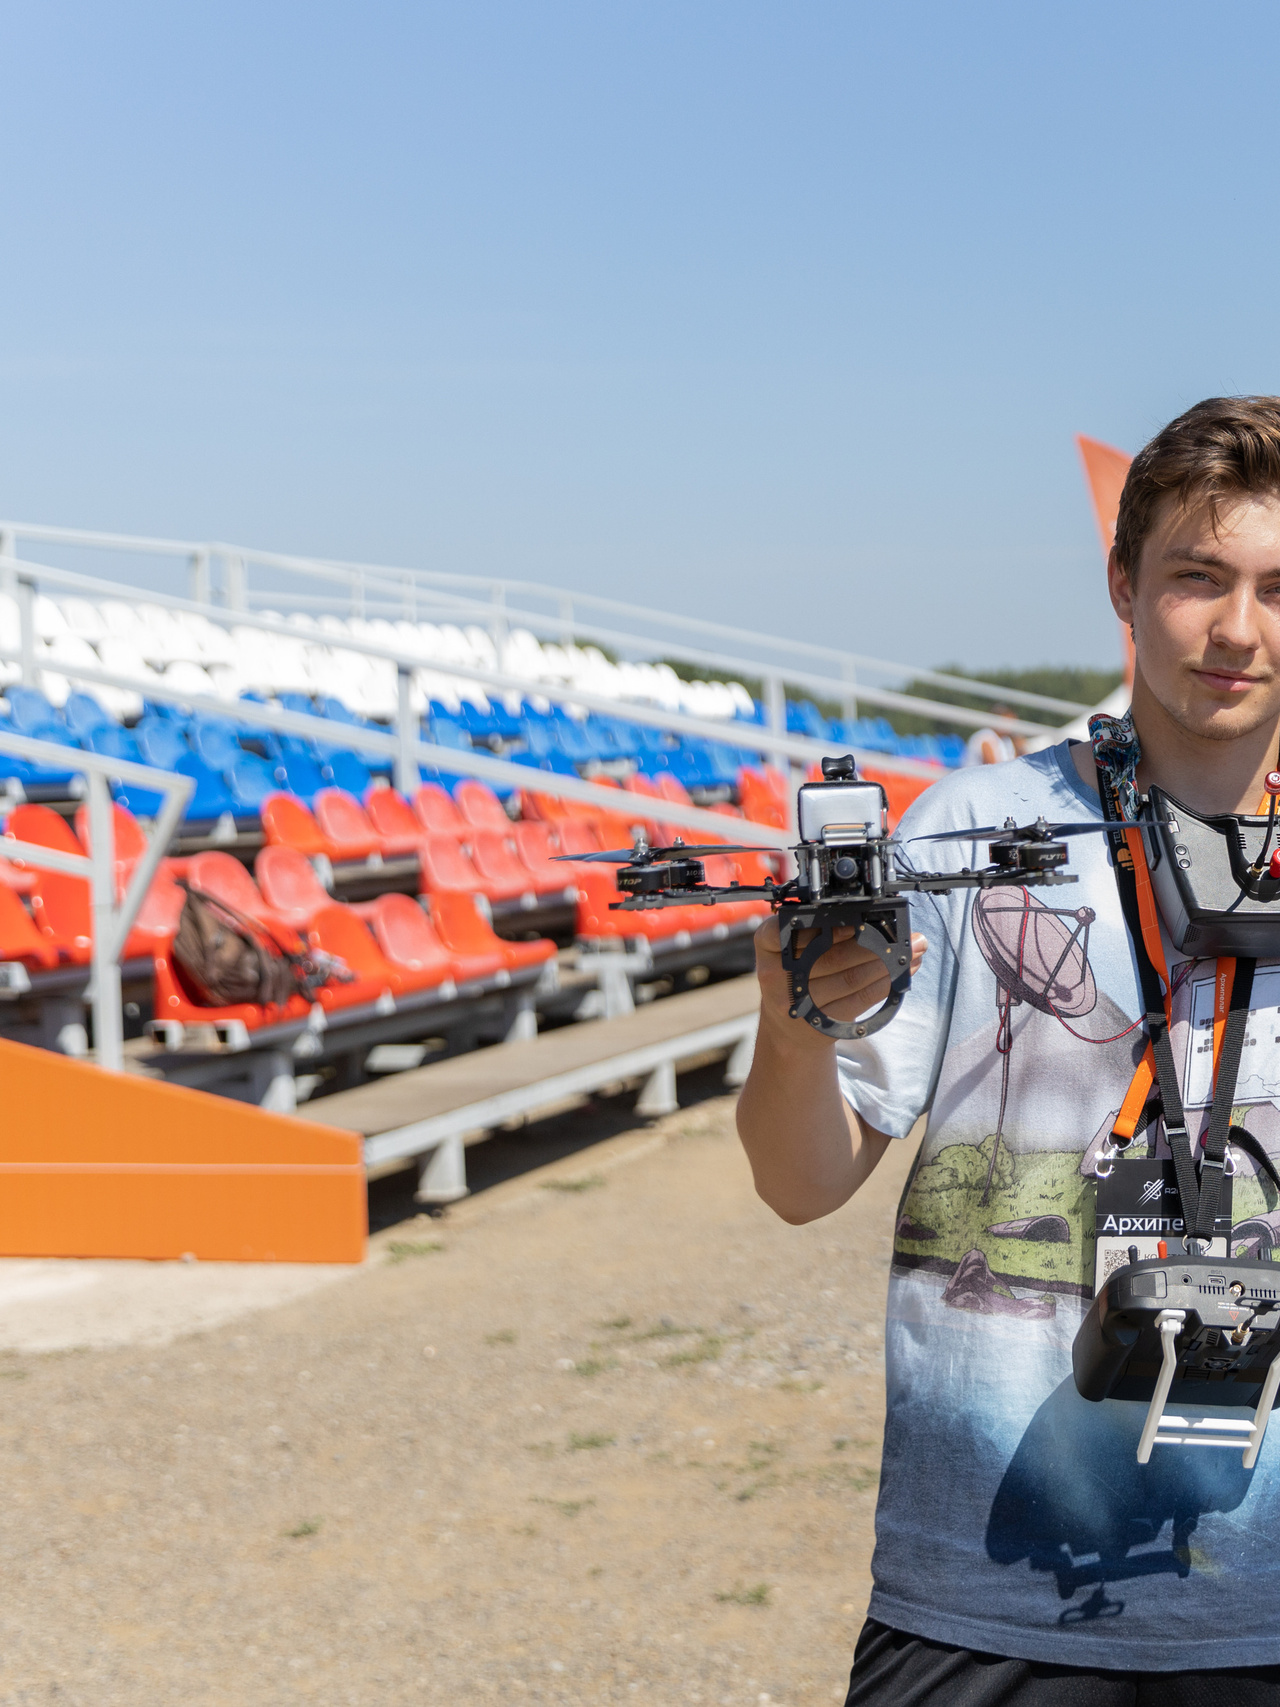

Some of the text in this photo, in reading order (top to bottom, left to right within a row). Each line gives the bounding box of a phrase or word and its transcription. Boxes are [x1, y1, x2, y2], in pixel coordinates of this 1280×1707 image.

[1106, 799, 1122, 845] TELMETRY
[1038, 853, 1067, 862] FLYTO
[1219, 972, 1228, 1014] Архипелаг
